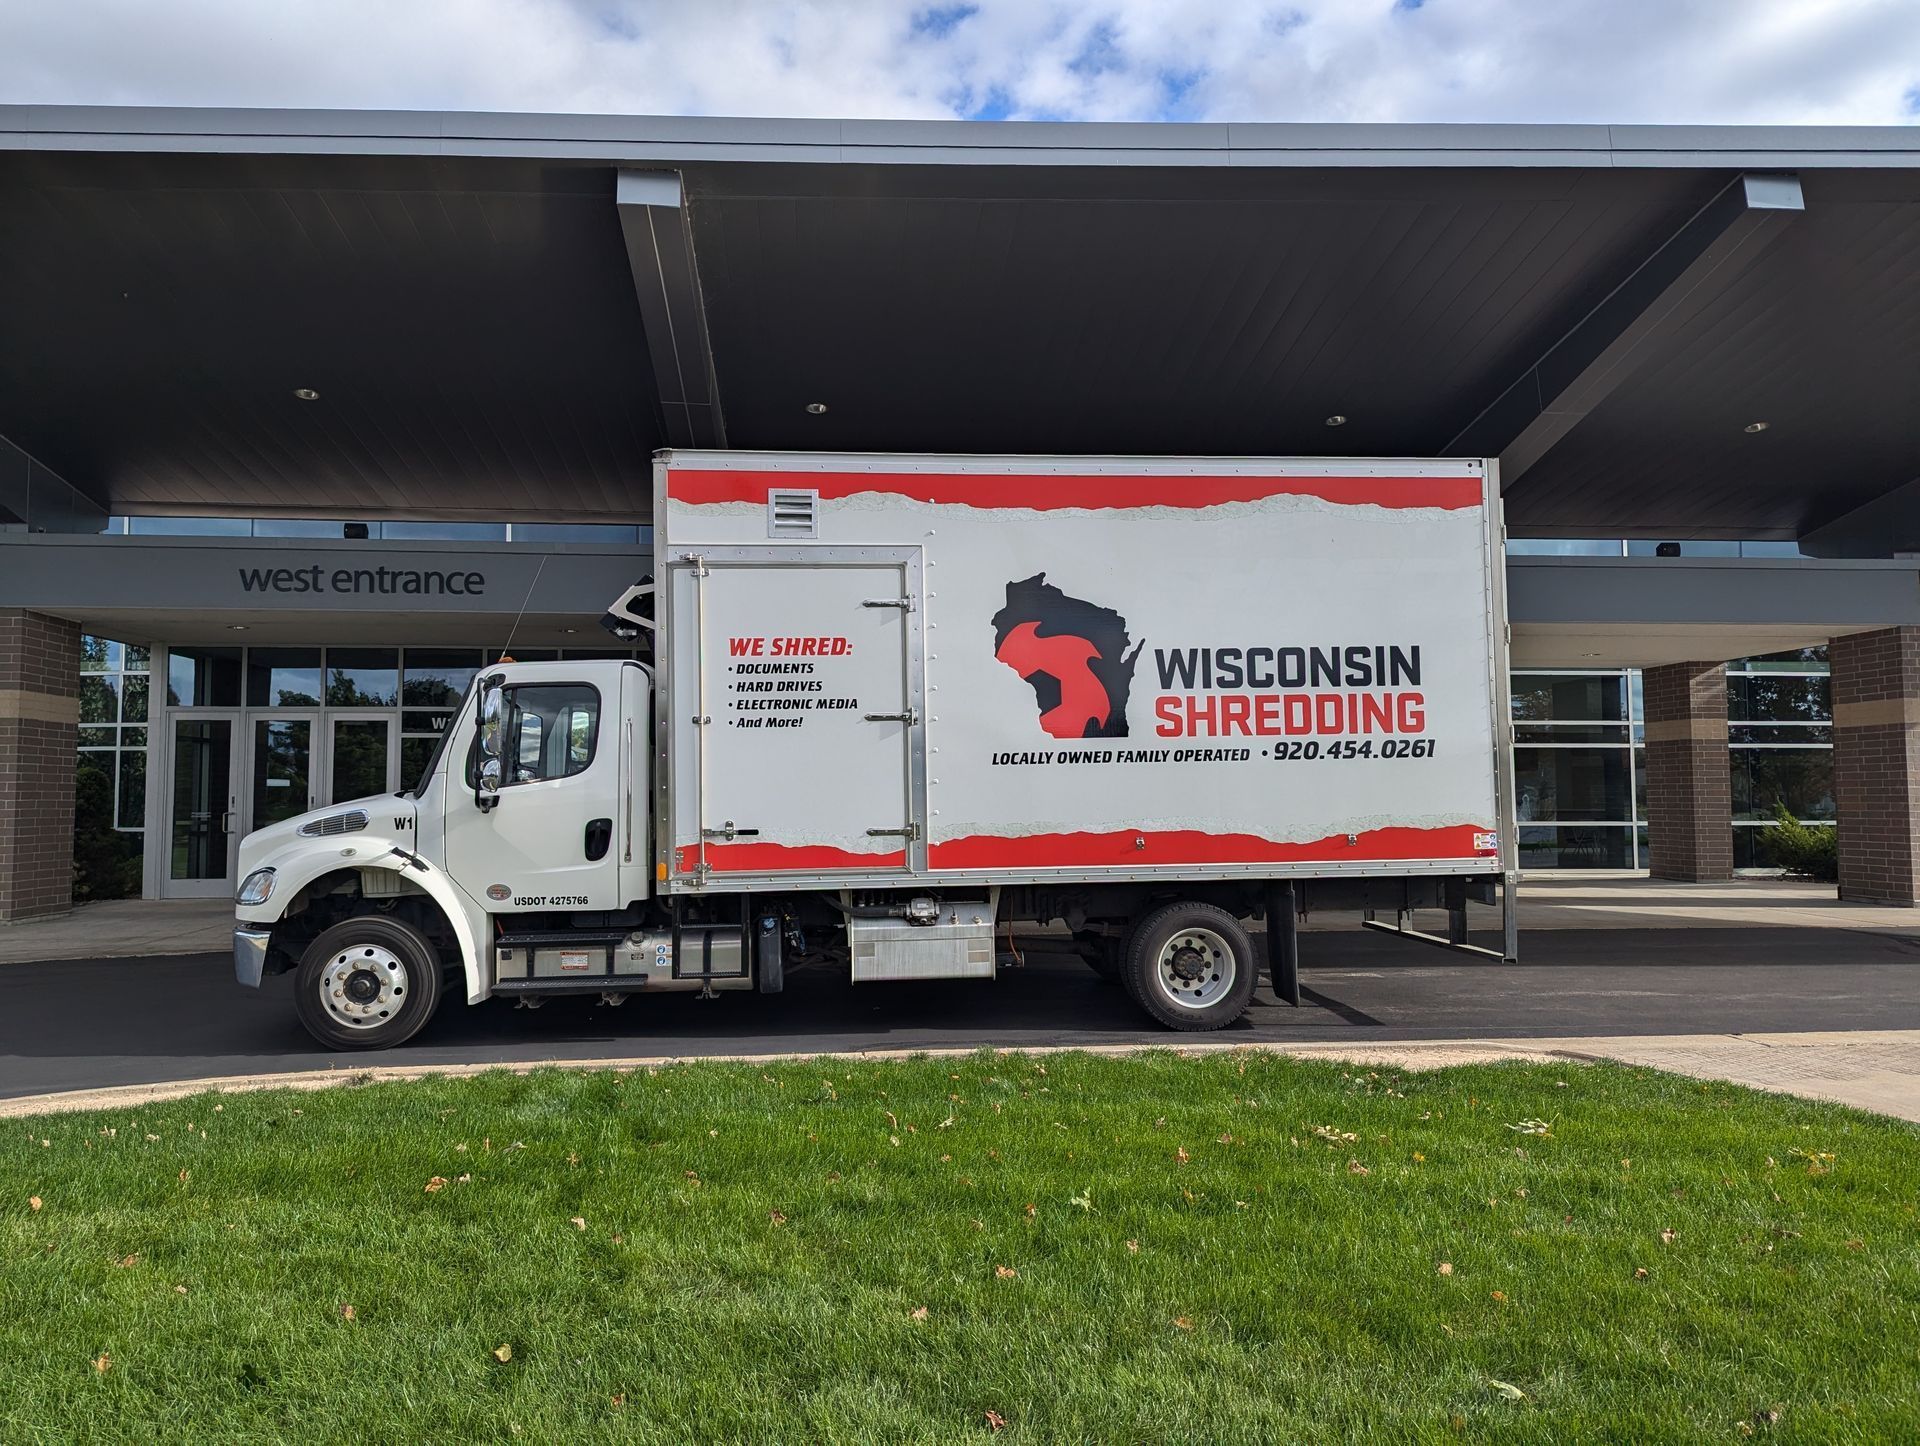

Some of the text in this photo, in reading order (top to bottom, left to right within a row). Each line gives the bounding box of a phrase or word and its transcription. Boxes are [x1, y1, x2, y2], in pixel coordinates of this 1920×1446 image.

[239, 565, 485, 595] west entrance
[729, 637, 853, 656] WE SHRED:
[736, 663, 814, 674] DOCUMENTS
[1154, 645, 1421, 690] WISCONSIN
[736, 681, 823, 692] HARD DRIVES
[736, 698, 858, 710] ELECTRONIC MEDIA
[1155, 692, 1426, 738] SHREDDING
[432, 717, 451, 729] W
[736, 717, 804, 728] And More!
[992, 739, 1436, 765] LOCALLY OWNED FAMILY OPERATED 920.454.0261
[393, 817, 413, 830] W1
[514, 896, 589, 906] USDOT 4275766
